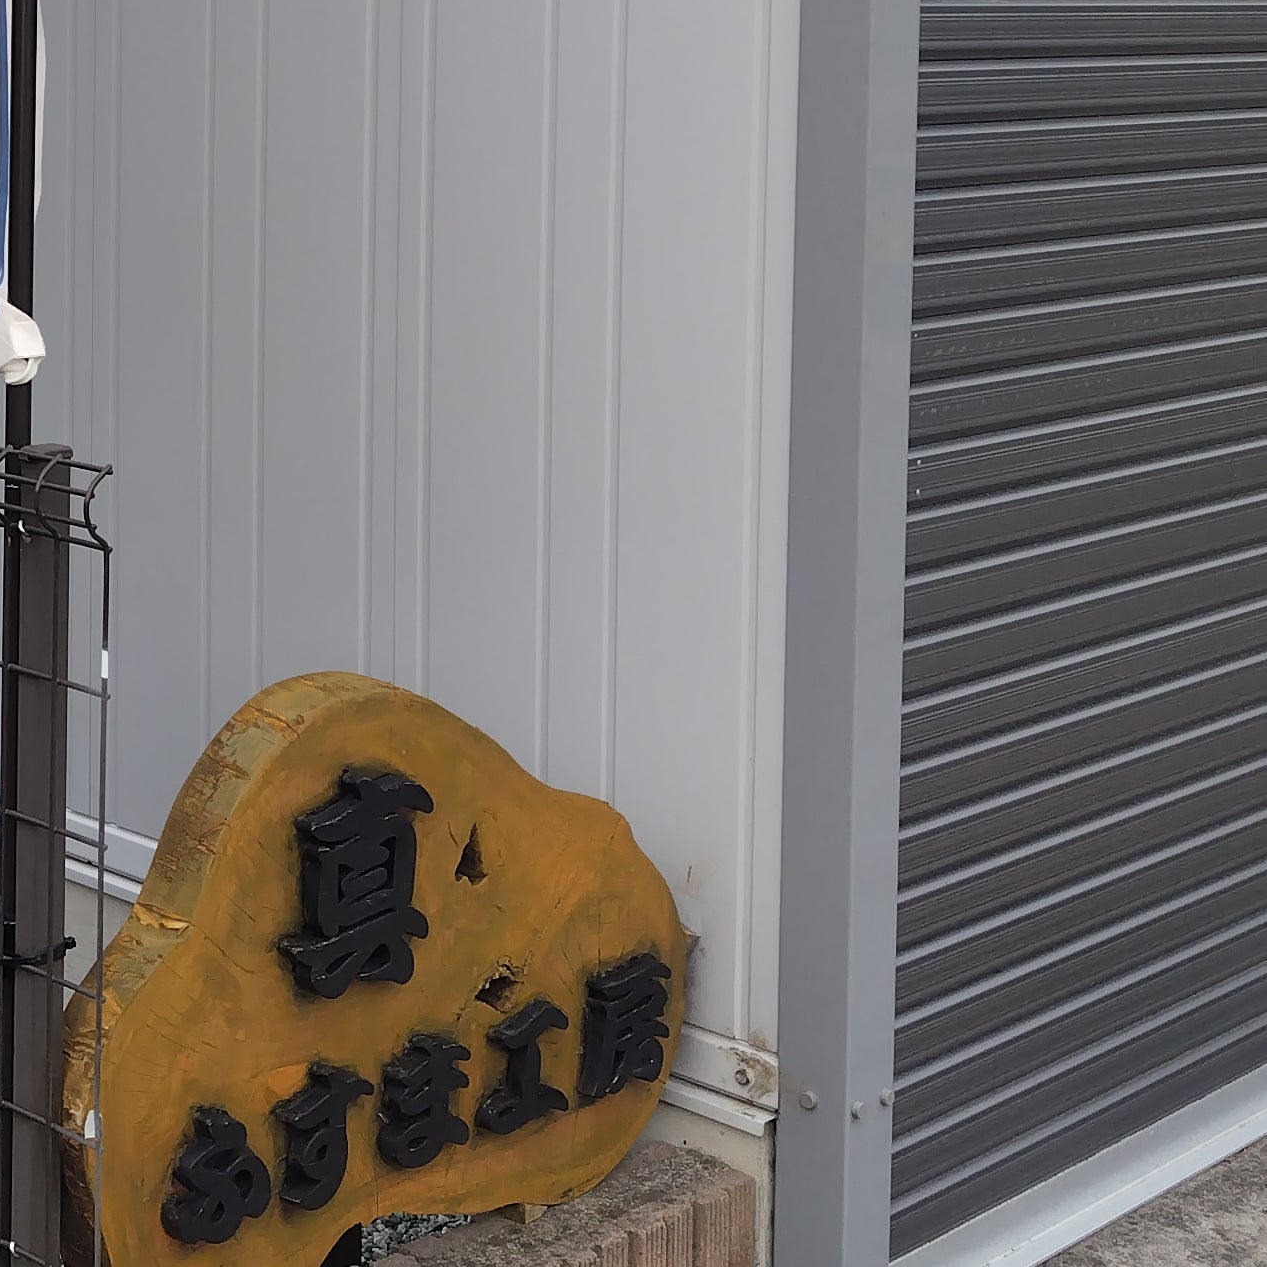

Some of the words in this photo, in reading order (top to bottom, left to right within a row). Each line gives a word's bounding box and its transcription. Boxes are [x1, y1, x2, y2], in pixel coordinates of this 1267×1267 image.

[161, 952, 672, 1245] ふすま工房
